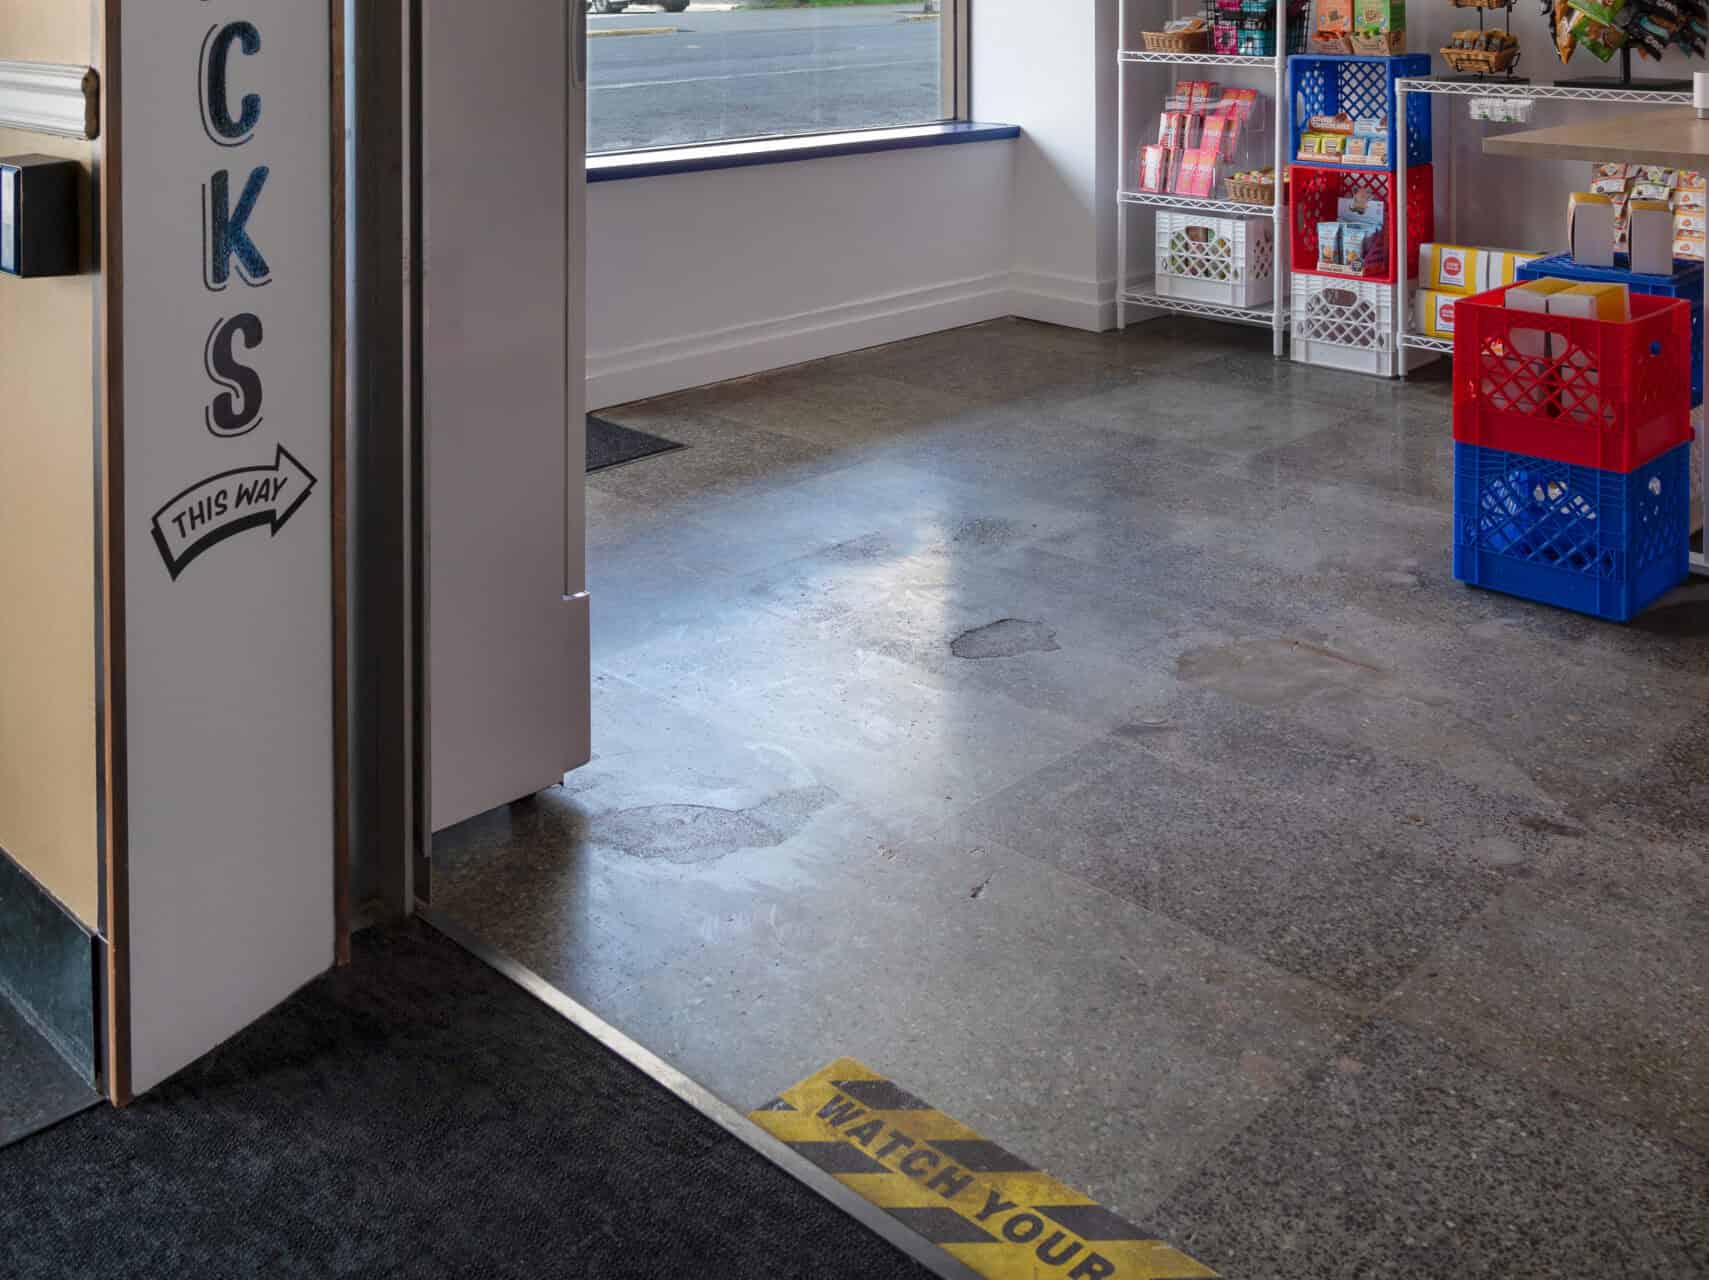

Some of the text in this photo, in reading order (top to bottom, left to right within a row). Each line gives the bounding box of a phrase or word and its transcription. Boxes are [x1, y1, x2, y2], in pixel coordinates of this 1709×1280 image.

[171, 476, 288, 538] THIS WAY
[816, 1093, 1116, 1280] WATCH YOUR
